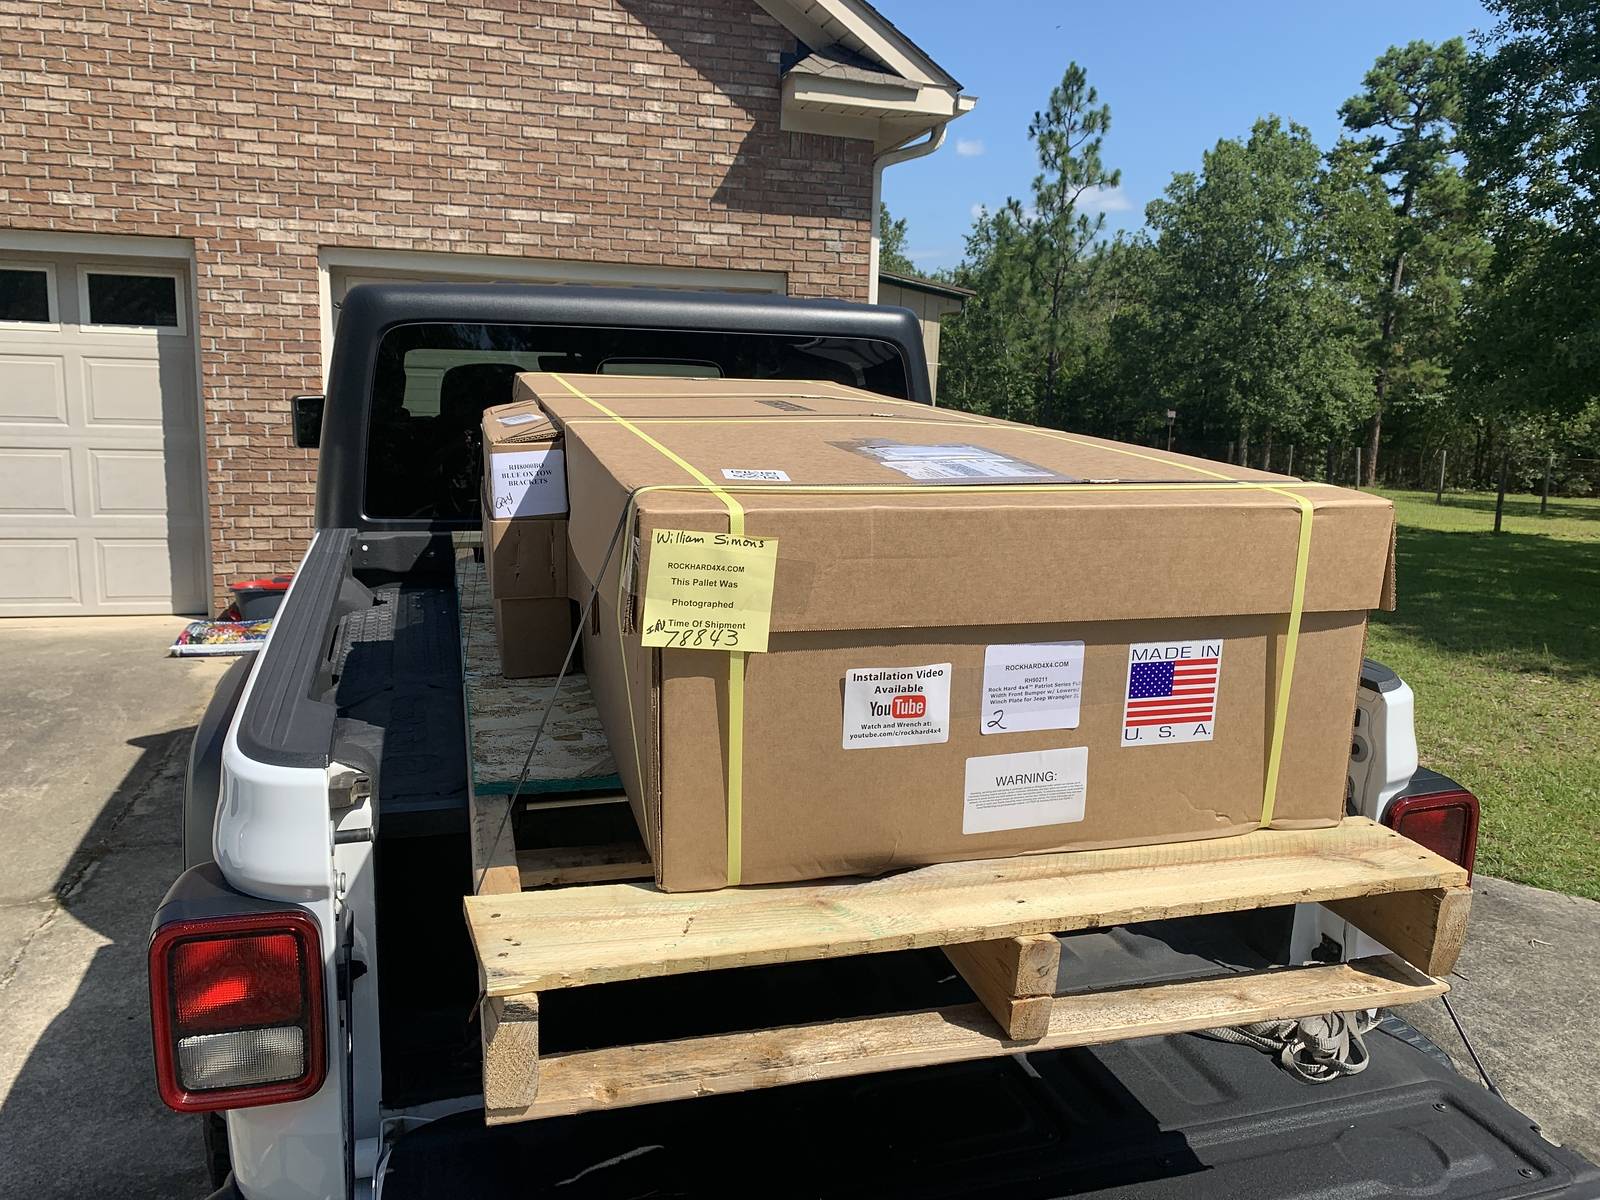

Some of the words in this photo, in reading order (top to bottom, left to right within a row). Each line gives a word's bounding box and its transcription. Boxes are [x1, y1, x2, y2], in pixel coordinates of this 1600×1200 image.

[508, 478, 549, 486] BRACKETS
[656, 531, 704, 544] William
[713, 534, 765, 548] Simons
[667, 562, 745, 573] ROCKHARD4X4.COM
[671, 577, 690, 586] This
[692, 578, 717, 587] Pallet
[719, 579, 738, 588] Was
[671, 598, 734, 610] Photographed
[668, 619, 690, 628] Time
[691, 620, 703, 628] Of
[705, 620, 746, 630] Shipment
[664, 628, 738, 647] 78843
[1132, 645, 1192, 661] MADE
[1201, 645, 1220, 658] IN
[1005, 661, 1070, 671] ROCKHARD4X4.COM
[853, 671, 913, 682] Installation
[916, 669, 944, 679] Video
[874, 683, 924, 694] Available
[1047, 694, 1072, 702] Wrangler
[870, 698, 924, 717] YouTube
[882, 721, 896, 729] and
[896, 720, 922, 729] Wrench
[986, 709, 1007, 730] 2
[849, 728, 942, 740] youtube.com/c/rockhard4x4
[995, 771, 1058, 787] WARNING:
